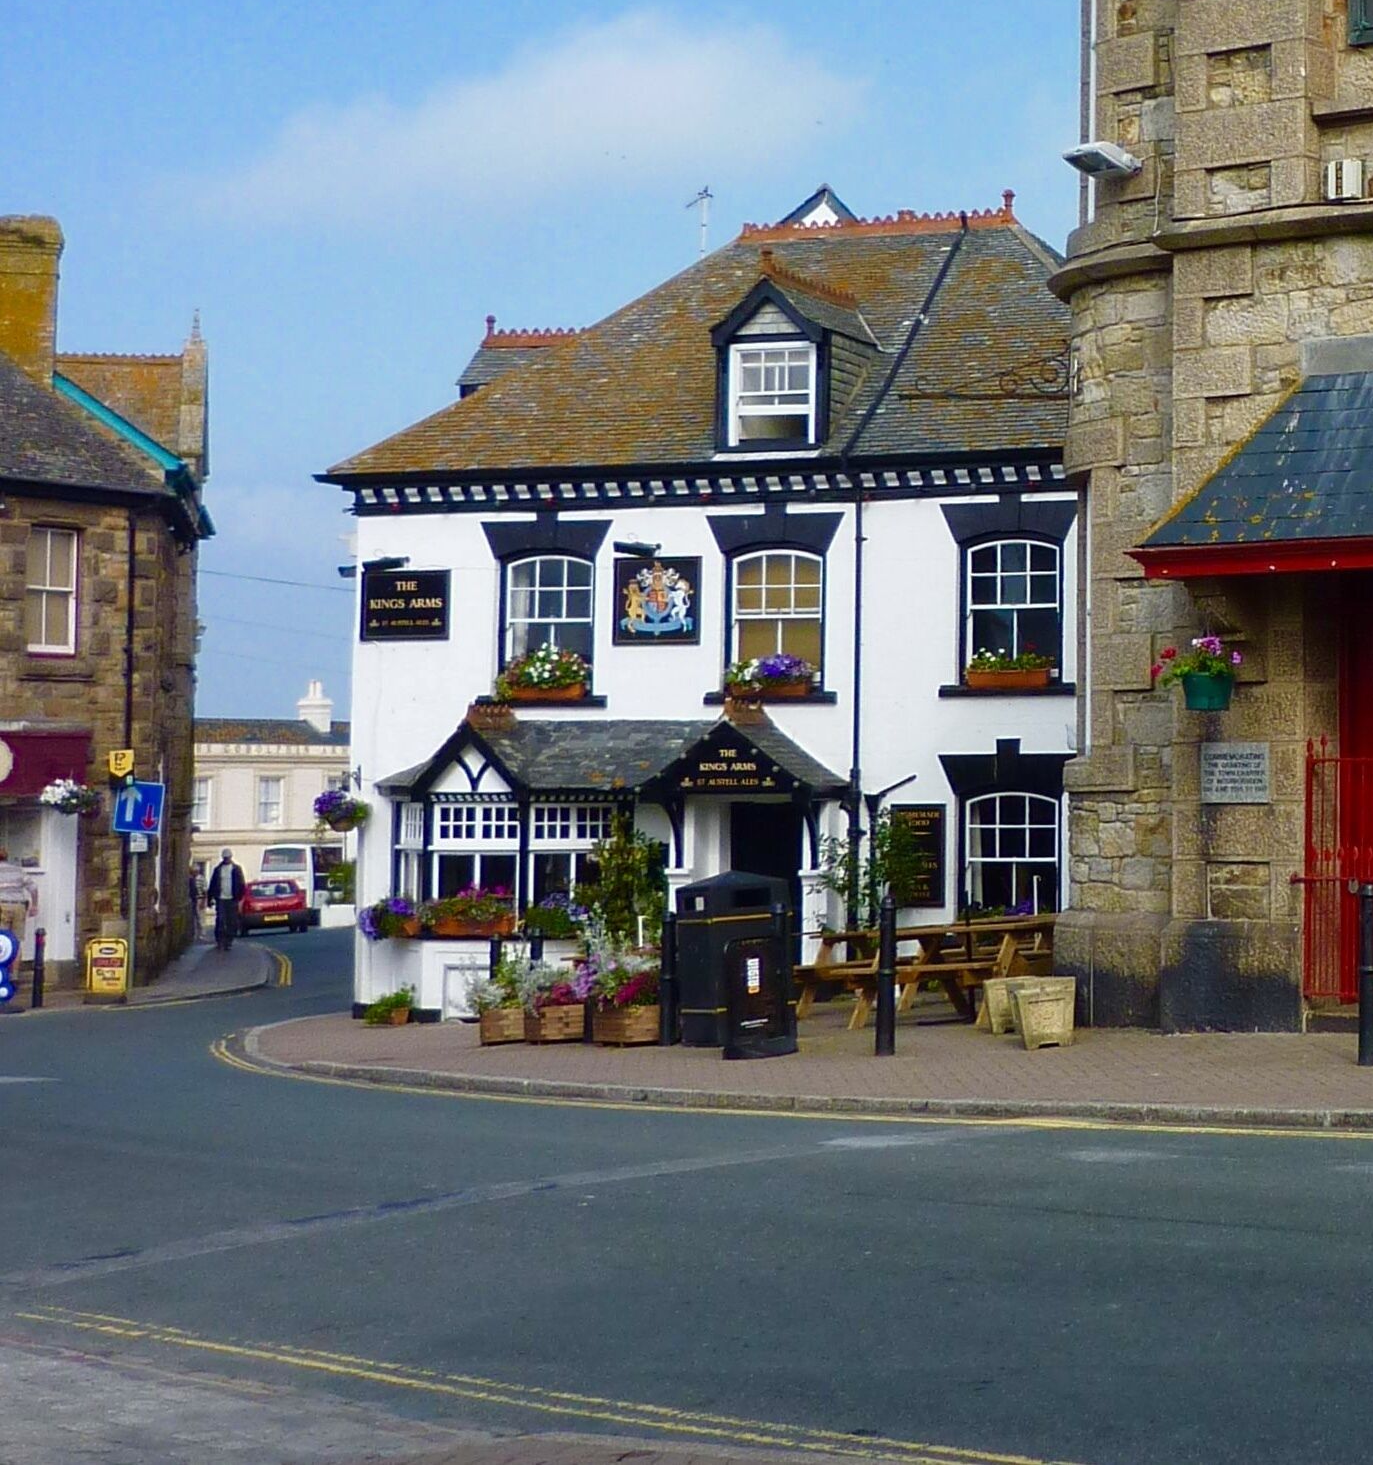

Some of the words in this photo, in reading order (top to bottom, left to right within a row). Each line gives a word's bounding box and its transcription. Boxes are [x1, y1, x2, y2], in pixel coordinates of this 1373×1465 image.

[395, 581, 418, 591] THE
[369, 598, 405, 609] KINGS
[409, 597, 443, 608] ARMS
[719, 749, 738, 758] THE
[699, 762, 728, 772] KINGS
[730, 762, 757, 772] ARMS
[708, 777, 738, 786] AUSTELL
[740, 777, 759, 785] ALES
